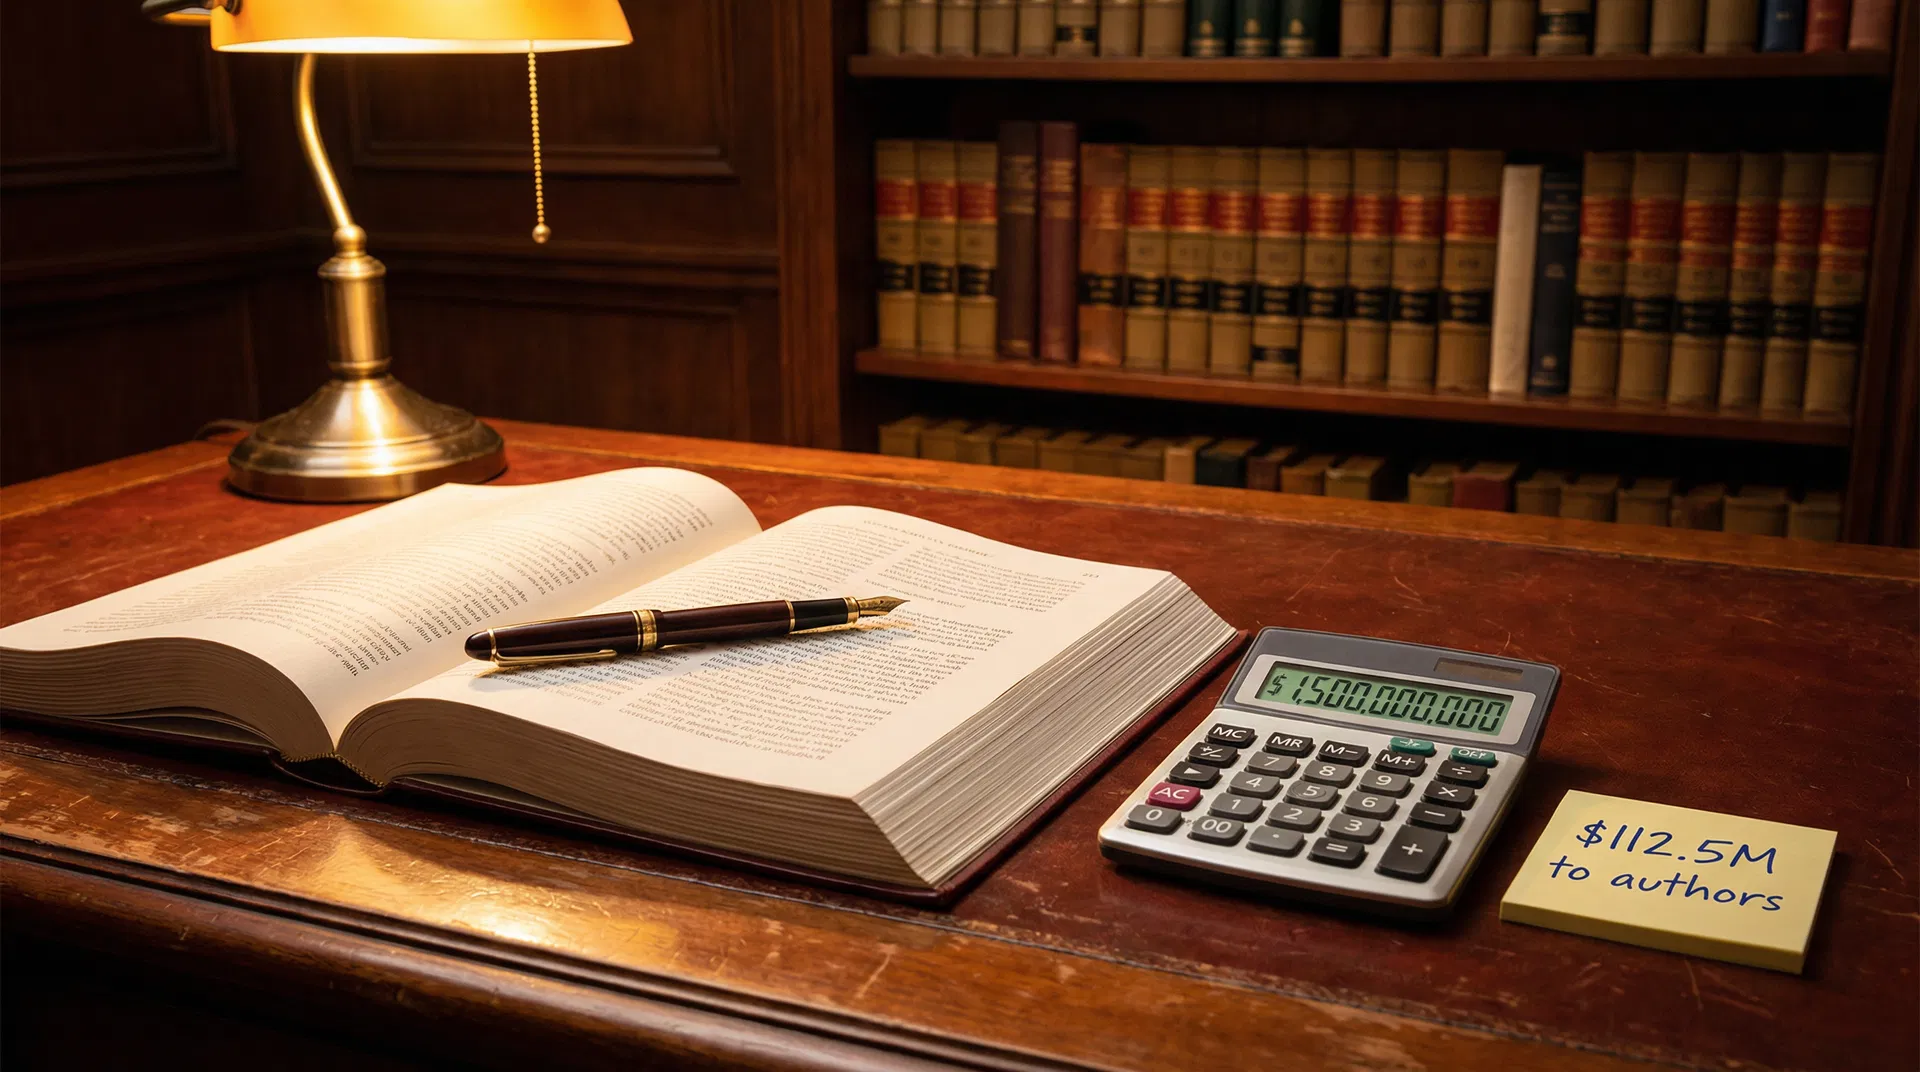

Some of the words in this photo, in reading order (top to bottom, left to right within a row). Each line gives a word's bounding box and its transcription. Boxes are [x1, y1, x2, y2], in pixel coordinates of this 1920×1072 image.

[1213, 726, 1246, 740] MC
[1271, 736, 1303, 748] MR
[1264, 757, 1279, 767] 7
[1381, 754, 1416, 766] M+
[1319, 765, 1336, 777] 8
[1246, 778, 1262, 788] 4
[1376, 775, 1392, 786] 9
[1154, 786, 1190, 800] AC
[1303, 785, 1321, 796] 5
[1232, 799, 1241, 810] 1
[1361, 796, 1379, 808] 6
[1145, 809, 1162, 821] 0
[1284, 808, 1302, 820] 2
[1201, 818, 1232, 833] 00
[1344, 819, 1363, 832] 3
[1576, 820, 1777, 874] $112.5M
[1549, 855, 1590, 881] to
[1610, 872, 1784, 912] authors
